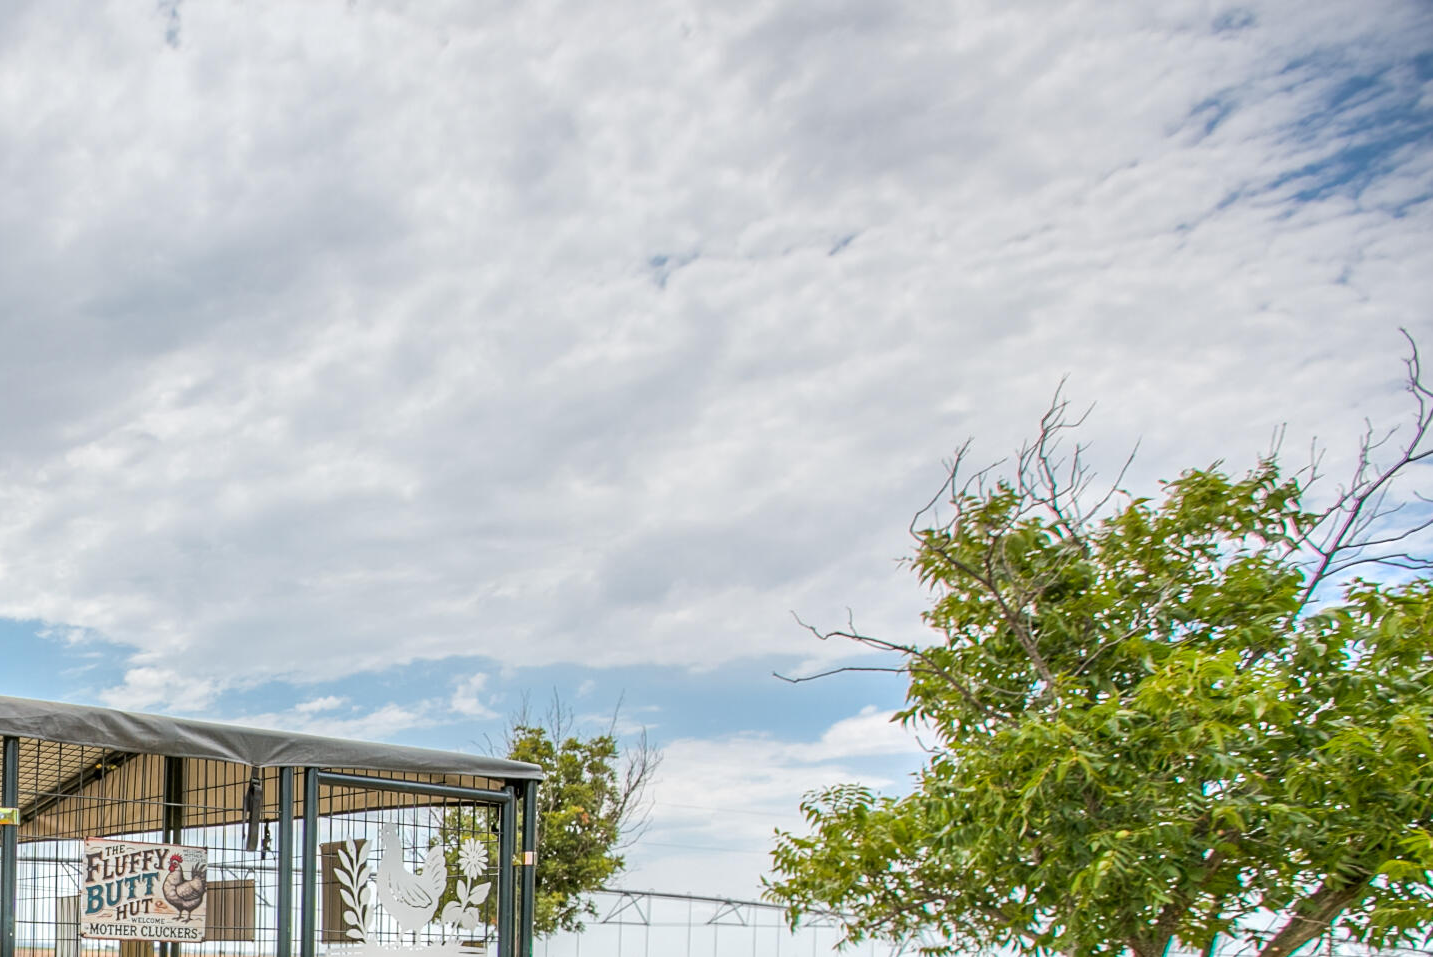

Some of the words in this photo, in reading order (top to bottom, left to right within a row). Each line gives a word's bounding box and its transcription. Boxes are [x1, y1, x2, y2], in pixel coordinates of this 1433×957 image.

[105, 844, 126, 857] THE
[85, 848, 170, 883] FLUFFY
[85, 872, 160, 915] BUTT
[116, 898, 153, 921] HUT
[131, 917, 165, 925] WELCOME
[89, 923, 138, 937] MOTHER
[140, 926, 198, 939] CLUCKERS
